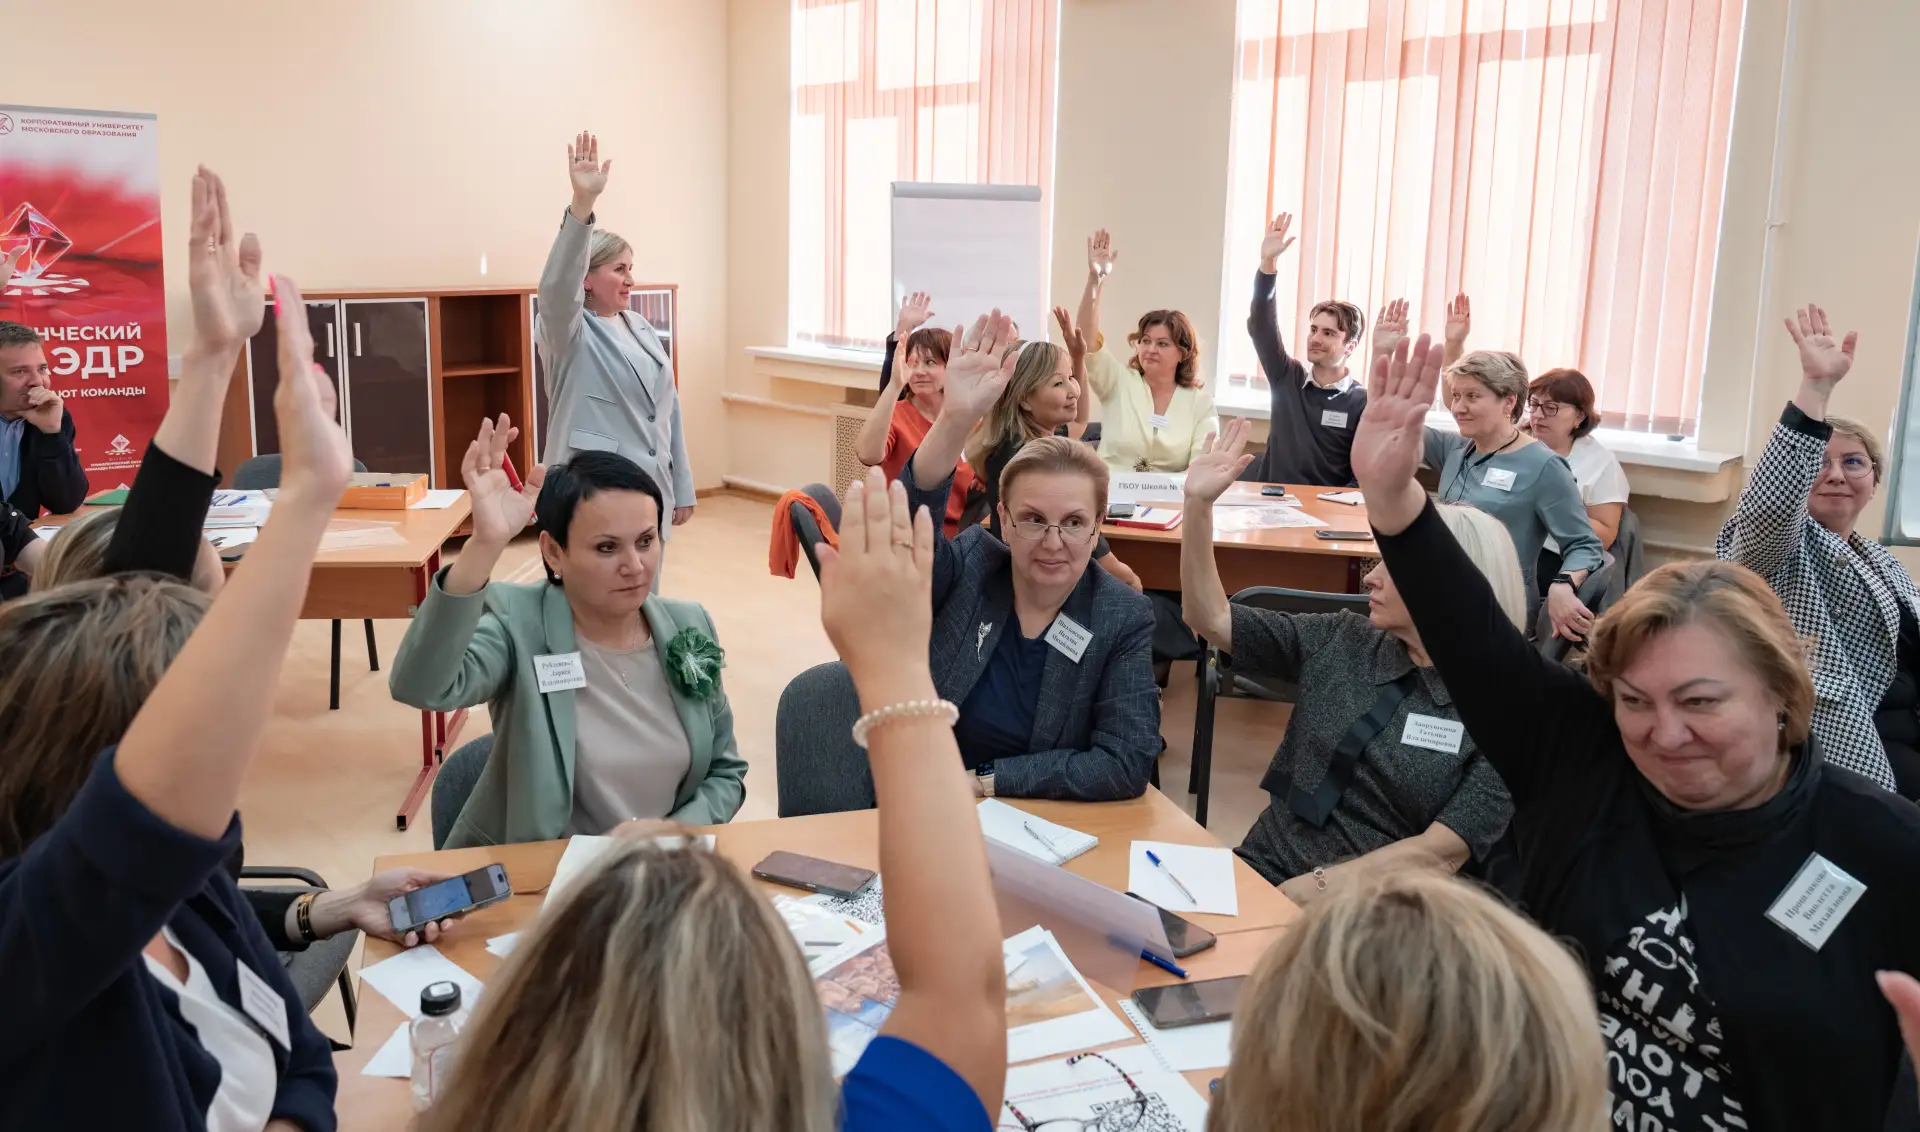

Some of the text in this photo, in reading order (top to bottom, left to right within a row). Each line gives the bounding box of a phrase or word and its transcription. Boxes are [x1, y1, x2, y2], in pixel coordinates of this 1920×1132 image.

[20, 118, 144, 131] КОРПОРАТИВНЫЙ УНИВЕРСИТЕТ
[21, 126, 80, 135] МОСКОВСКОГО
[34, 322, 142, 341] НЧЕСКИЙ
[49, 345, 145, 380] ЭДР
[80, 386, 146, 397] КОМАНДЫ
[1406, 733, 1456, 748] Владимировна
[1419, 729, 1447, 739] Татьяна
[1802, 883, 1836, 921] Виолетта
[1809, 885, 1852, 935] Михайловна
